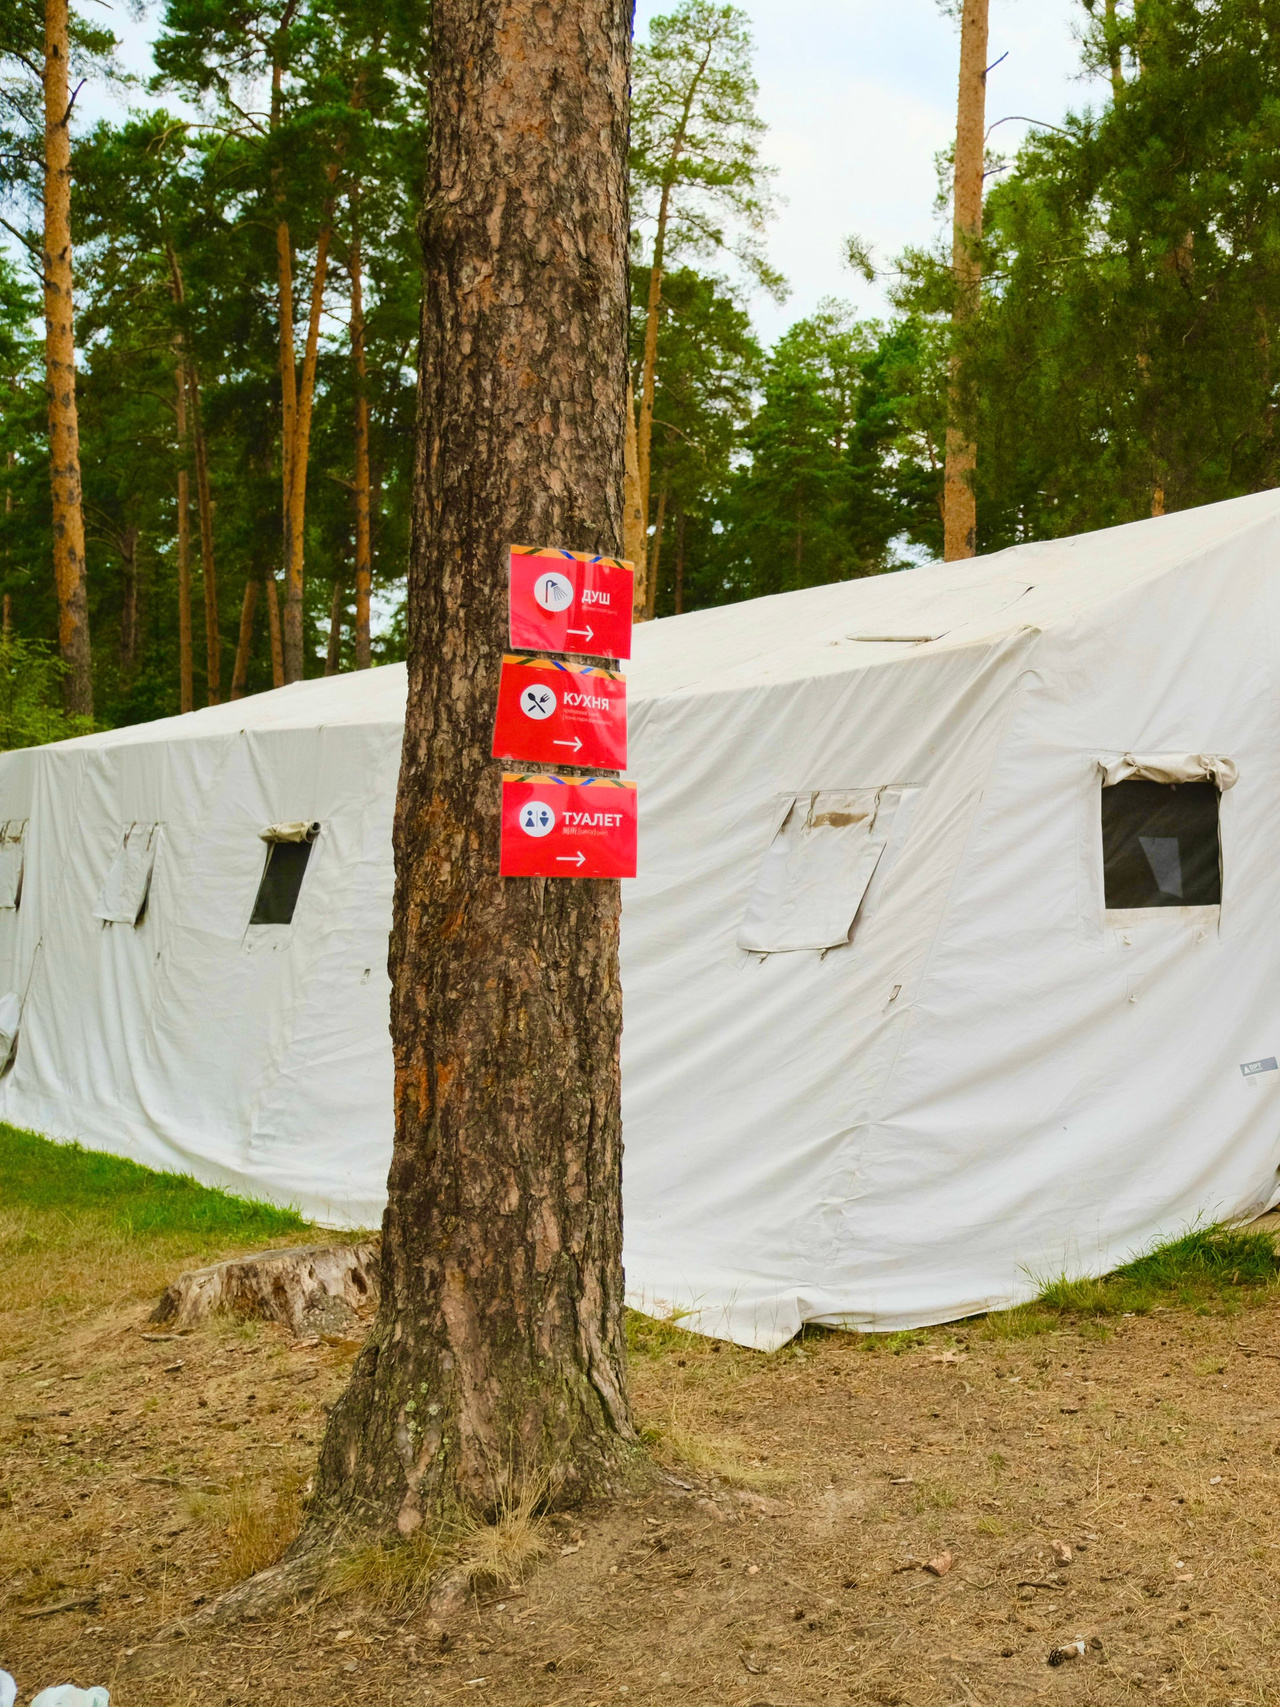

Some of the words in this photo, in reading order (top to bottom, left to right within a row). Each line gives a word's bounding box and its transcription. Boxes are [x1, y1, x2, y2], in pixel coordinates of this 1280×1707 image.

[581, 589, 610, 605] ДУШ
[563, 692, 609, 711] КУХНЯ
[562, 812, 623, 827] ТУАЛЕТ
